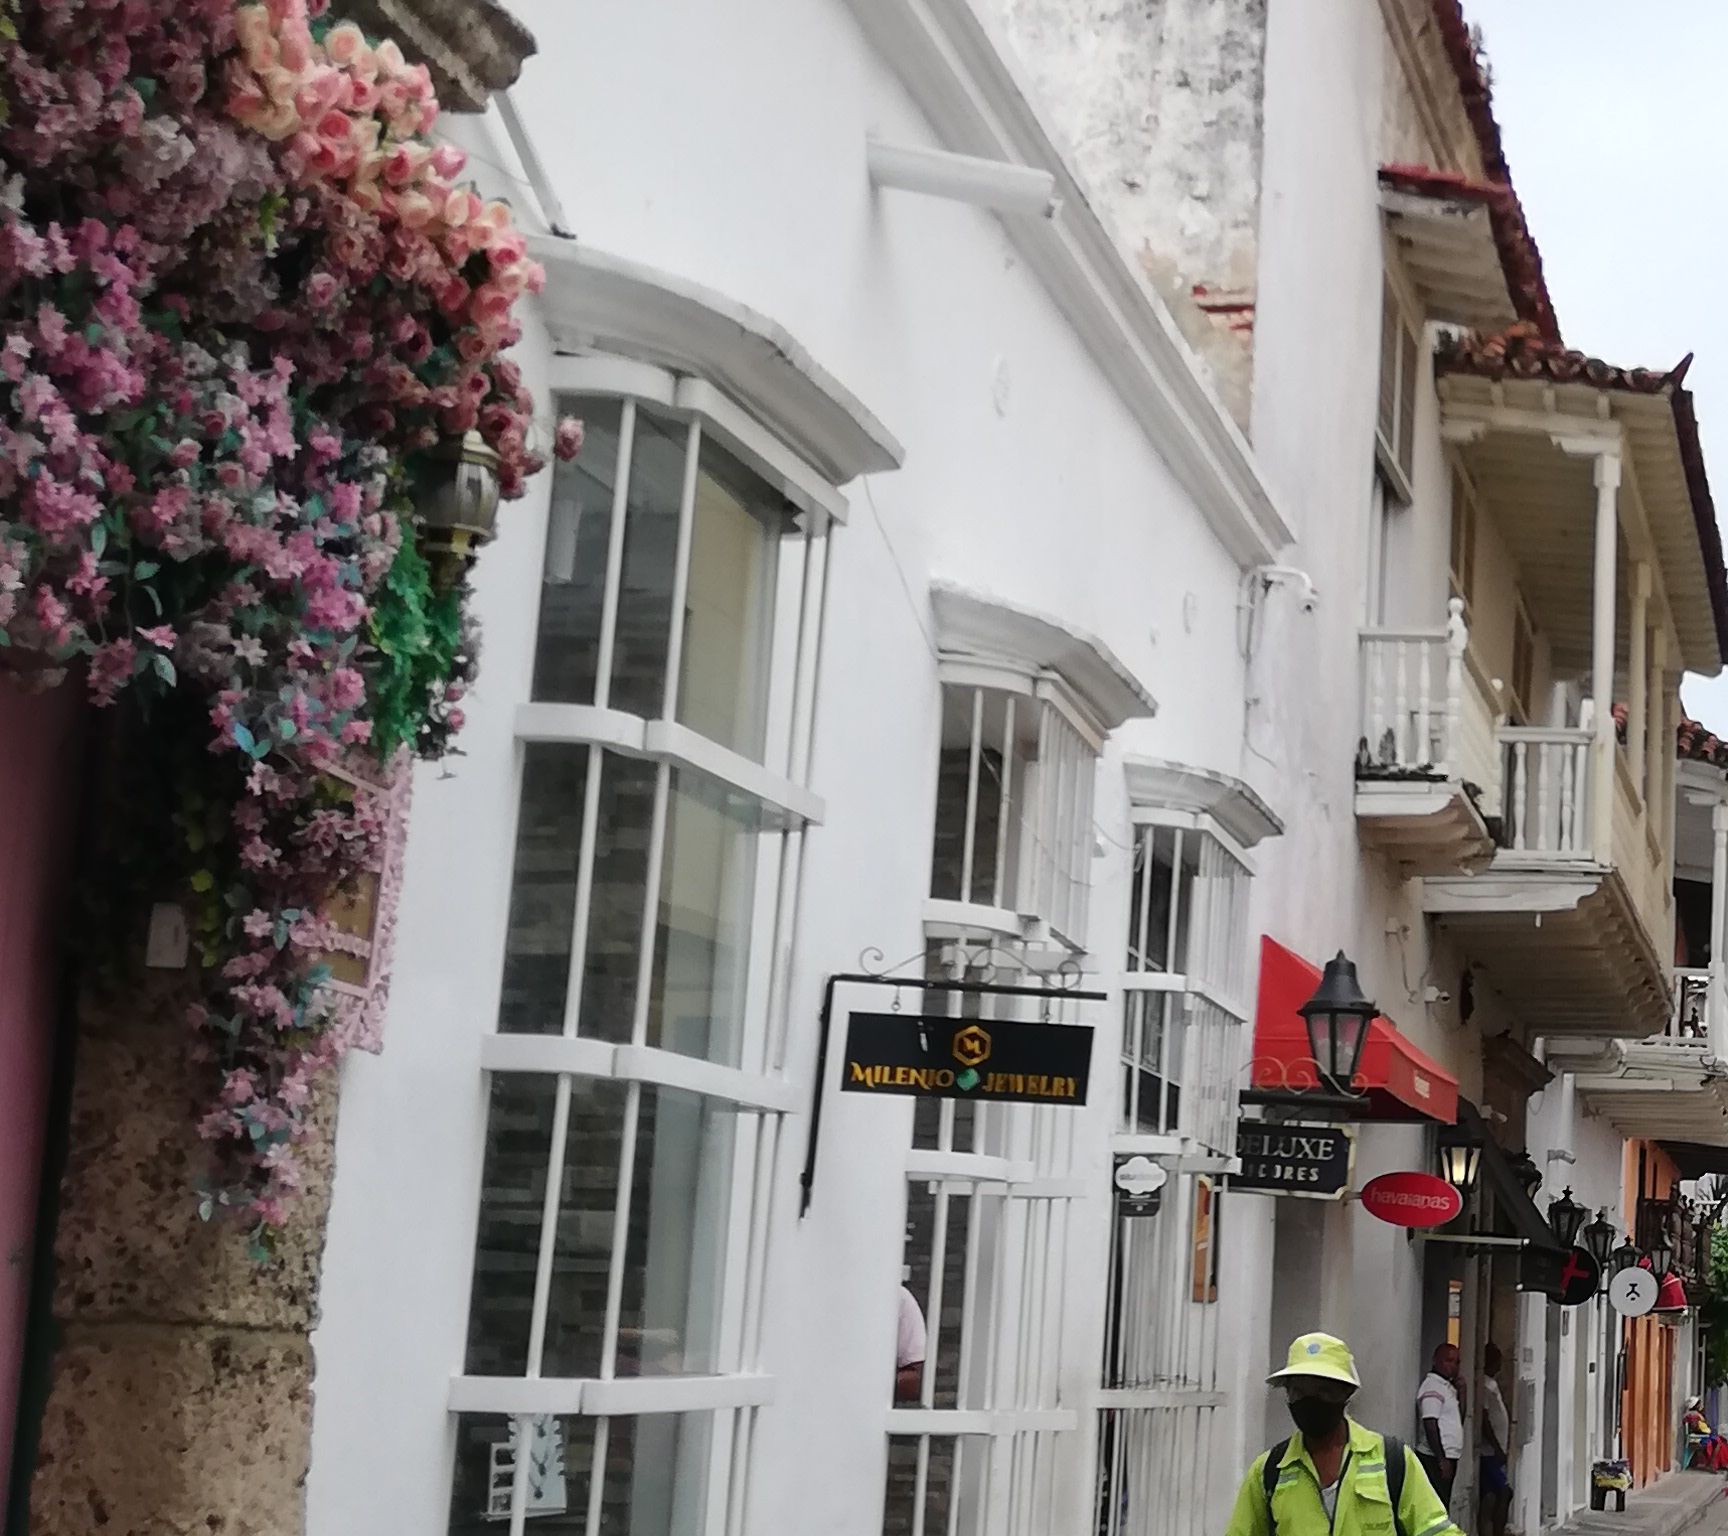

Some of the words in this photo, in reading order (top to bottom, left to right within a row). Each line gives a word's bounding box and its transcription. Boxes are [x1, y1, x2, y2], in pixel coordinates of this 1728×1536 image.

[850, 1061, 955, 1090] MILENIO
[981, 1072, 1078, 1097] JEWELRY
[1370, 1186, 1450, 1211] havaianas
